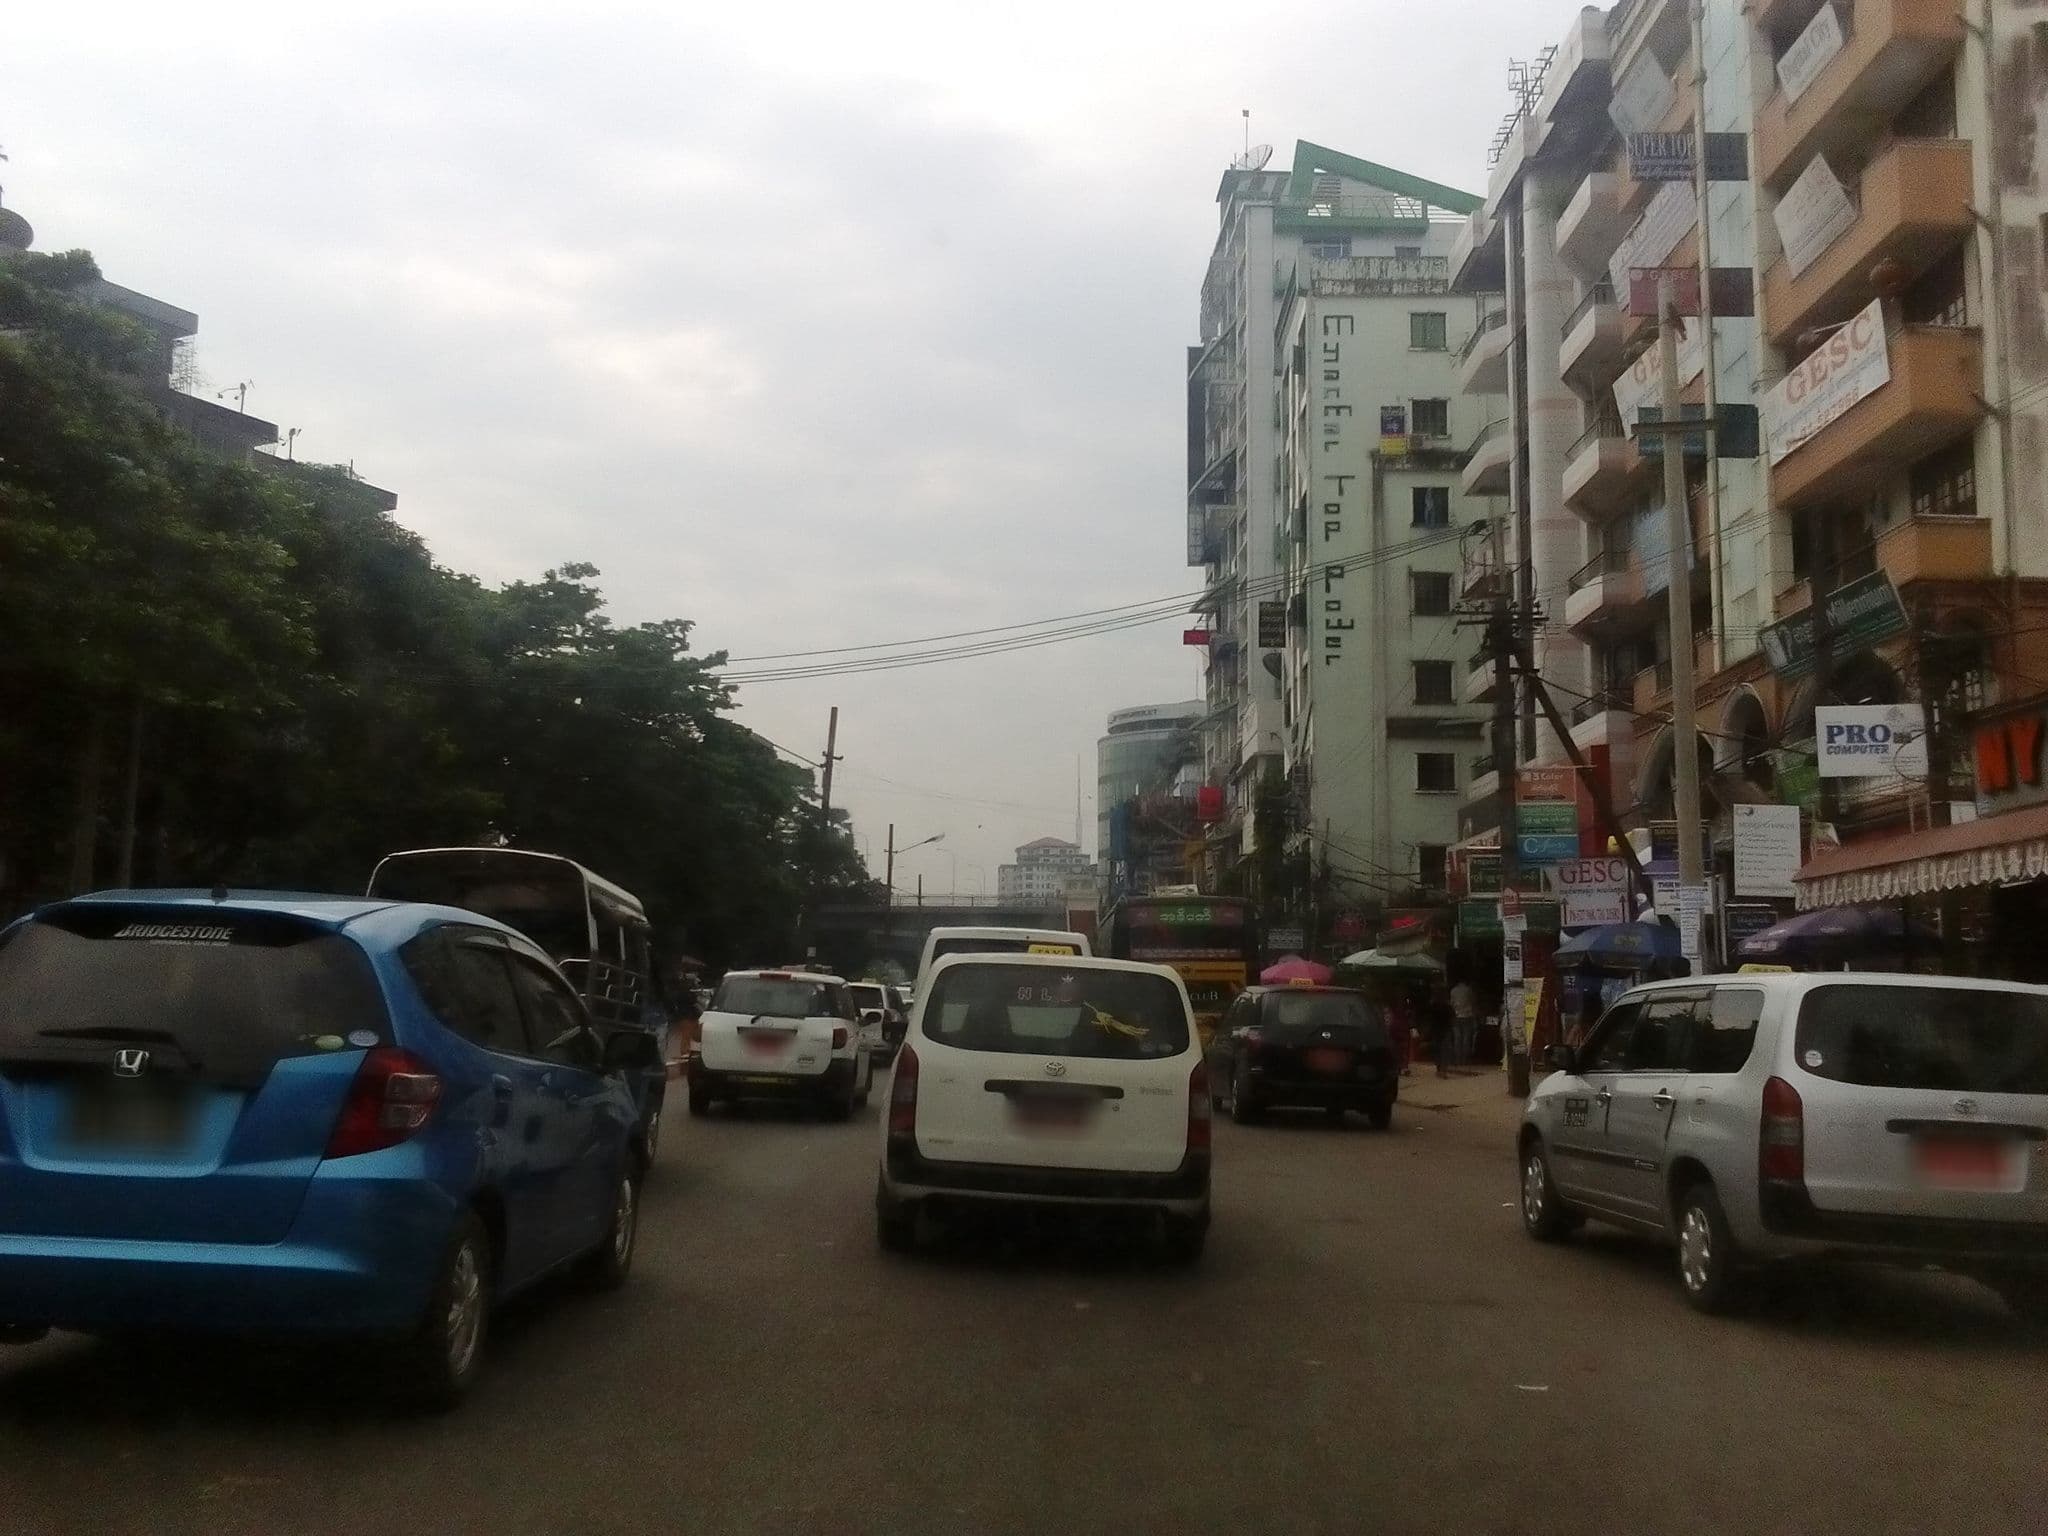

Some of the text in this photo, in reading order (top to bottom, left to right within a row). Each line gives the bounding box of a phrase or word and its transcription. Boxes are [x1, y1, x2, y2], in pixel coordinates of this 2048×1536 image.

[1785, 311, 1873, 404] GESC
[1826, 724, 1891, 744] PRO
[1827, 744, 1889, 755] COMPUTER
[1559, 859, 1625, 884] GESC
[112, 923, 233, 940] BRIDGESTONE
